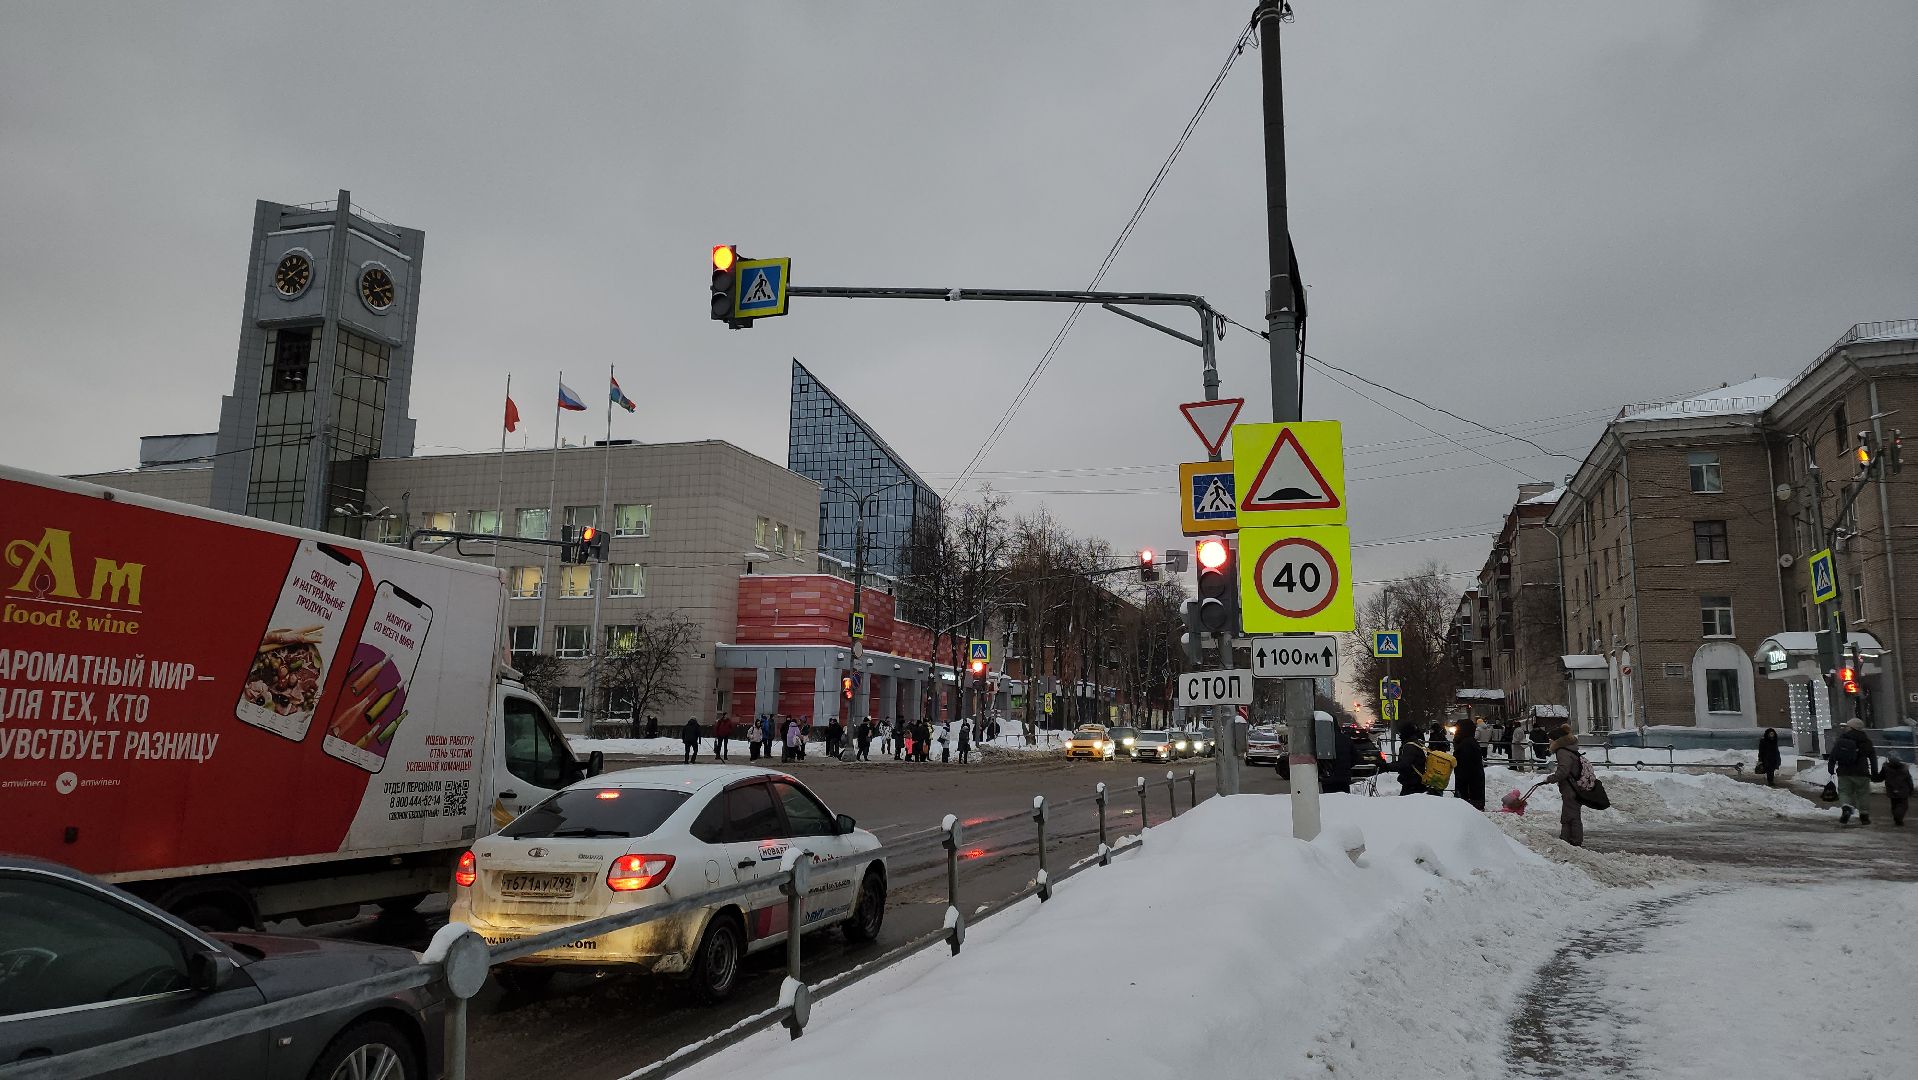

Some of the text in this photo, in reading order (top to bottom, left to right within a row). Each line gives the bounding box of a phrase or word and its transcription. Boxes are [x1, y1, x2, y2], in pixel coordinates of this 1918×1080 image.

[310, 569, 338, 592] СВЕЖИЕ
[1272, 562, 1320, 593] 40
[292, 575, 346, 612] И НАТУРАЛЬНЫЕ
[295, 594, 333, 621] ПРОДУКТЫ
[3, 603, 140, 635] food & wine
[0, 648, 145, 688] АРОМАТНЫЙ
[149, 660, 195, 691] МИР
[1188, 676, 1241, 700] СТОП
[50, 690, 98, 725] ТЕХ,
[106, 693, 150, 723] КТО
[123, 731, 219, 763] РАЗНИЦУ
[2, 779, 47, 788] amwineru
[80, 777, 121, 787] amwineru
[383, 781, 442, 795] ОТДЕЛ ПЕРСОНАЛА
[506, 876, 550, 891] Т671АУ
